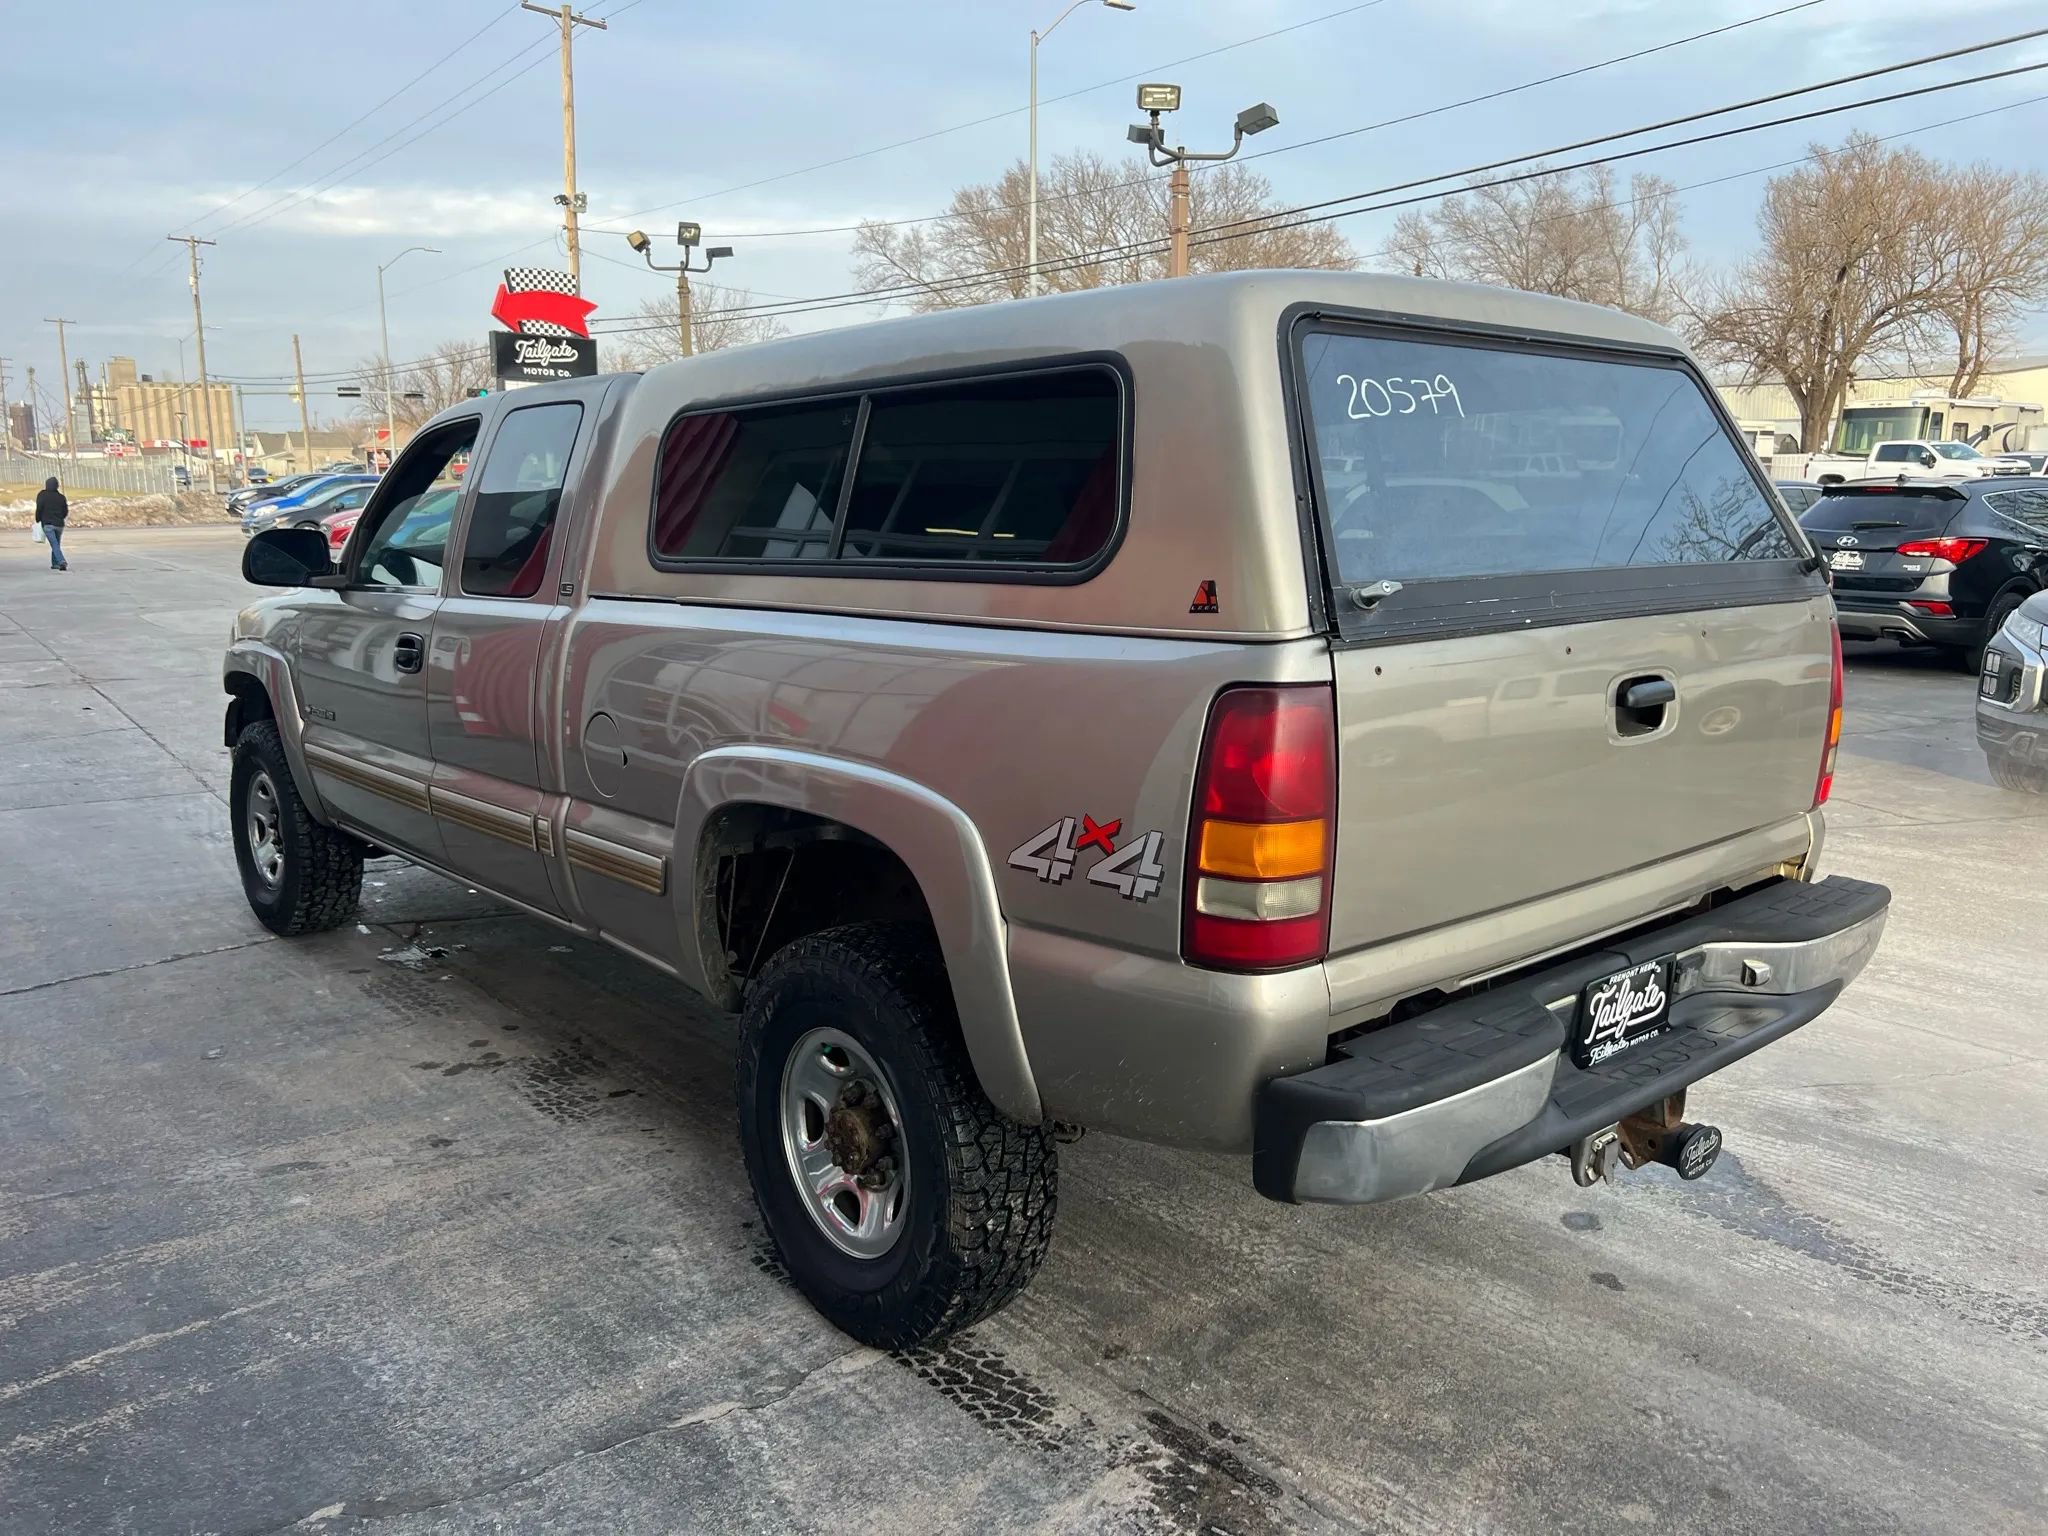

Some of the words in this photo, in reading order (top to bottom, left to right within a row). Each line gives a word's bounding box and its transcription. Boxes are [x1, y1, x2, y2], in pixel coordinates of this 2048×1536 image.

[514, 338, 579, 366] Tailgate
[524, 368, 555, 376] MOTOR
[1337, 374, 1465, 420] 20579
[1609, 967, 1639, 985] FREMONT
[1584, 973, 1666, 1045] Tailgate
[1588, 1037, 1629, 1067] Tailgate
[1630, 1033, 1650, 1047] MOTOR
[1685, 1130, 1719, 1170] Tailgate
